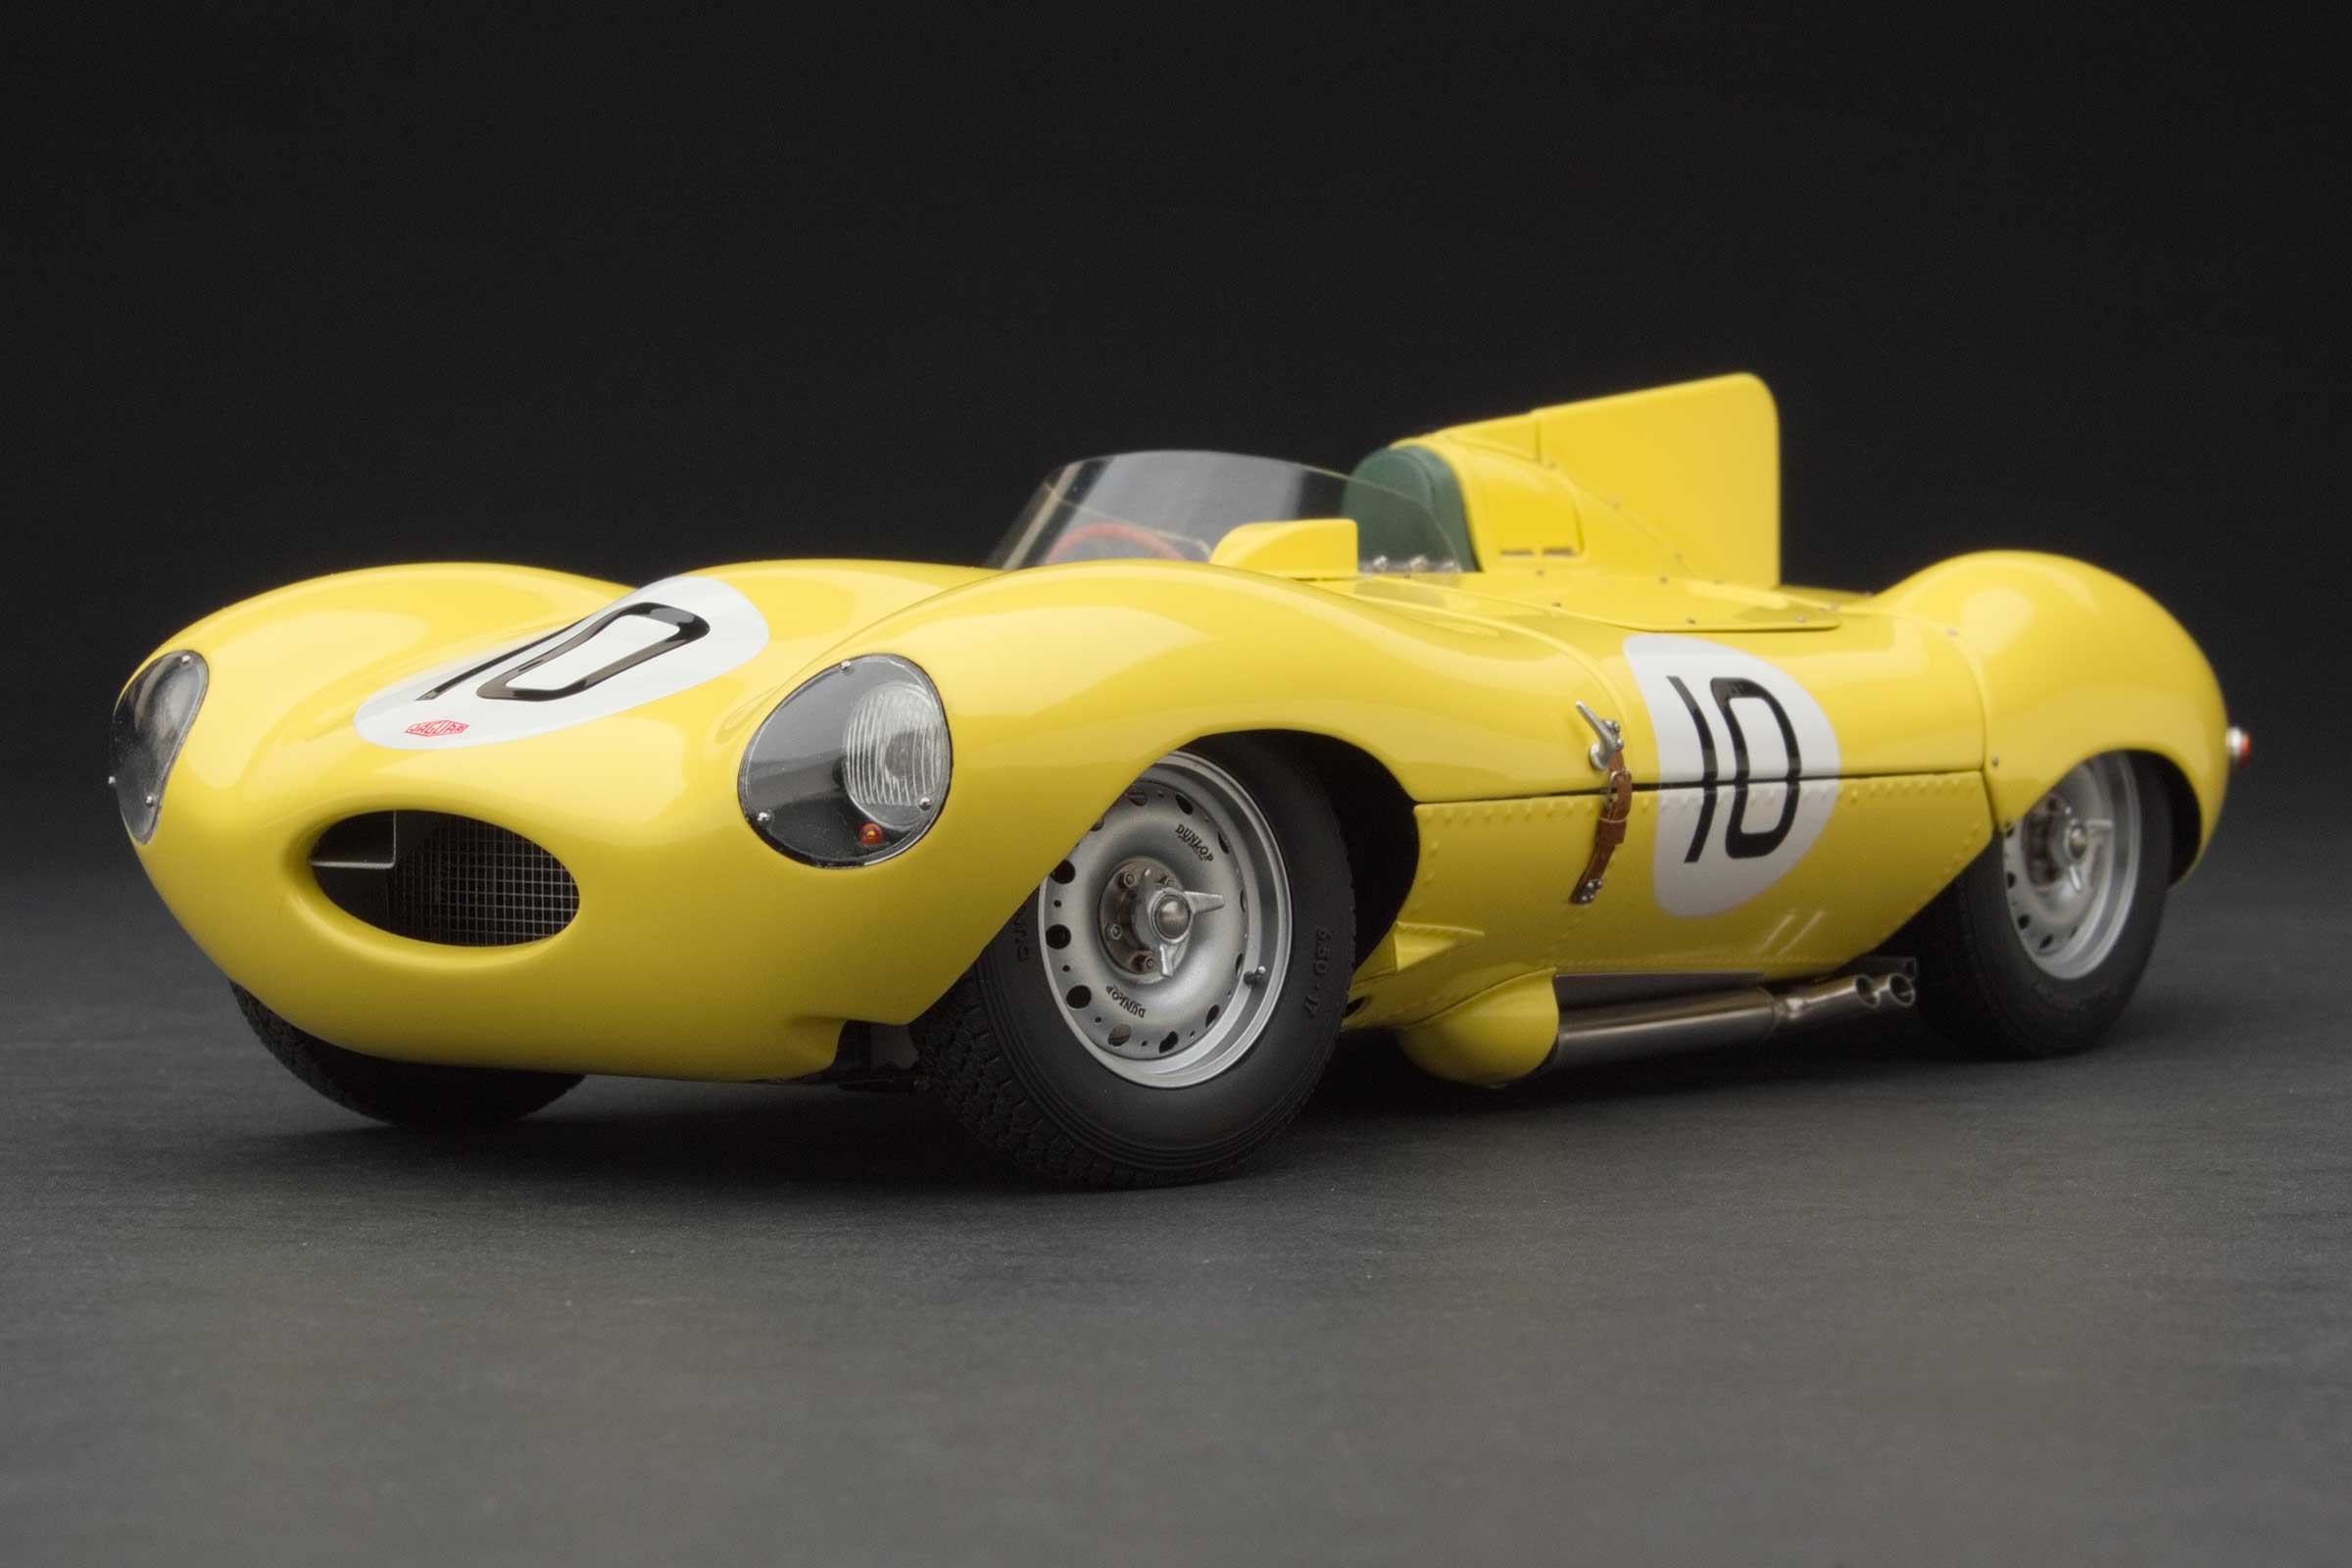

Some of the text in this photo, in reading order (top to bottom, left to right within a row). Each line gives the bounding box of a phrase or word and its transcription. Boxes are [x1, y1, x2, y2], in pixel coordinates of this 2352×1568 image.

[416, 602, 710, 702] 10
[407, 721, 466, 736] JAGUAR
[1666, 675, 1801, 863] 10
[1176, 823, 1214, 861] DUNLOP
[1106, 985, 1146, 1018] DUNLOP
